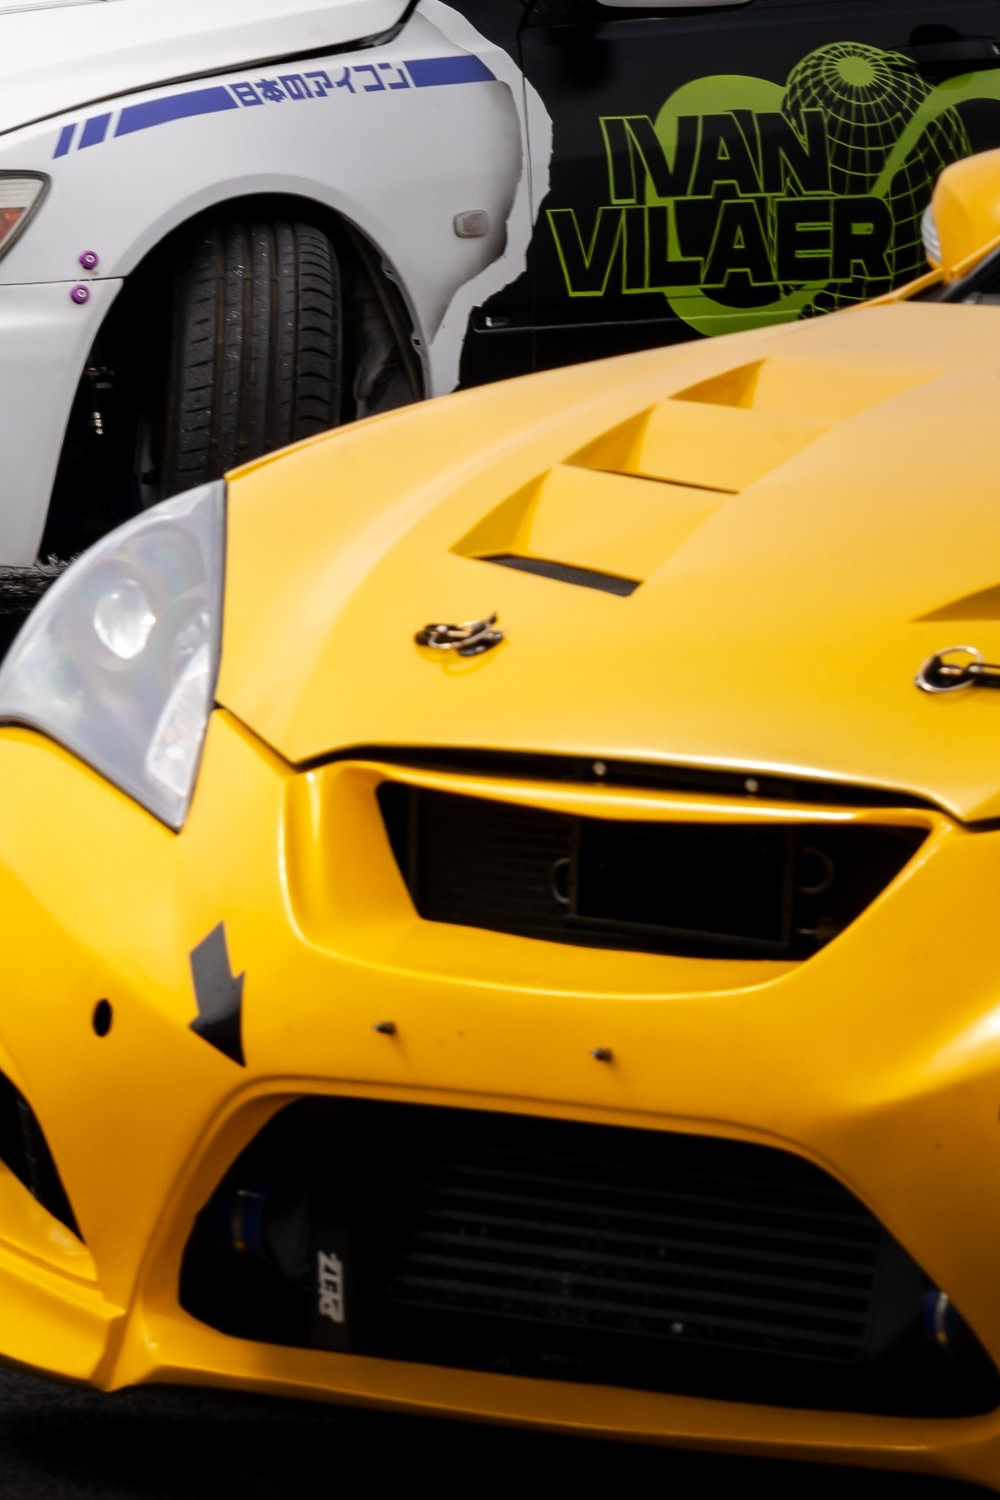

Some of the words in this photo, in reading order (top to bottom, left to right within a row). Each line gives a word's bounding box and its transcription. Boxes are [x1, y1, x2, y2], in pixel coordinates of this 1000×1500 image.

[228, 62, 411, 108] 日本のアイコン
[599, 108, 832, 204] IVAN
[546, 195, 894, 297] VILAER
